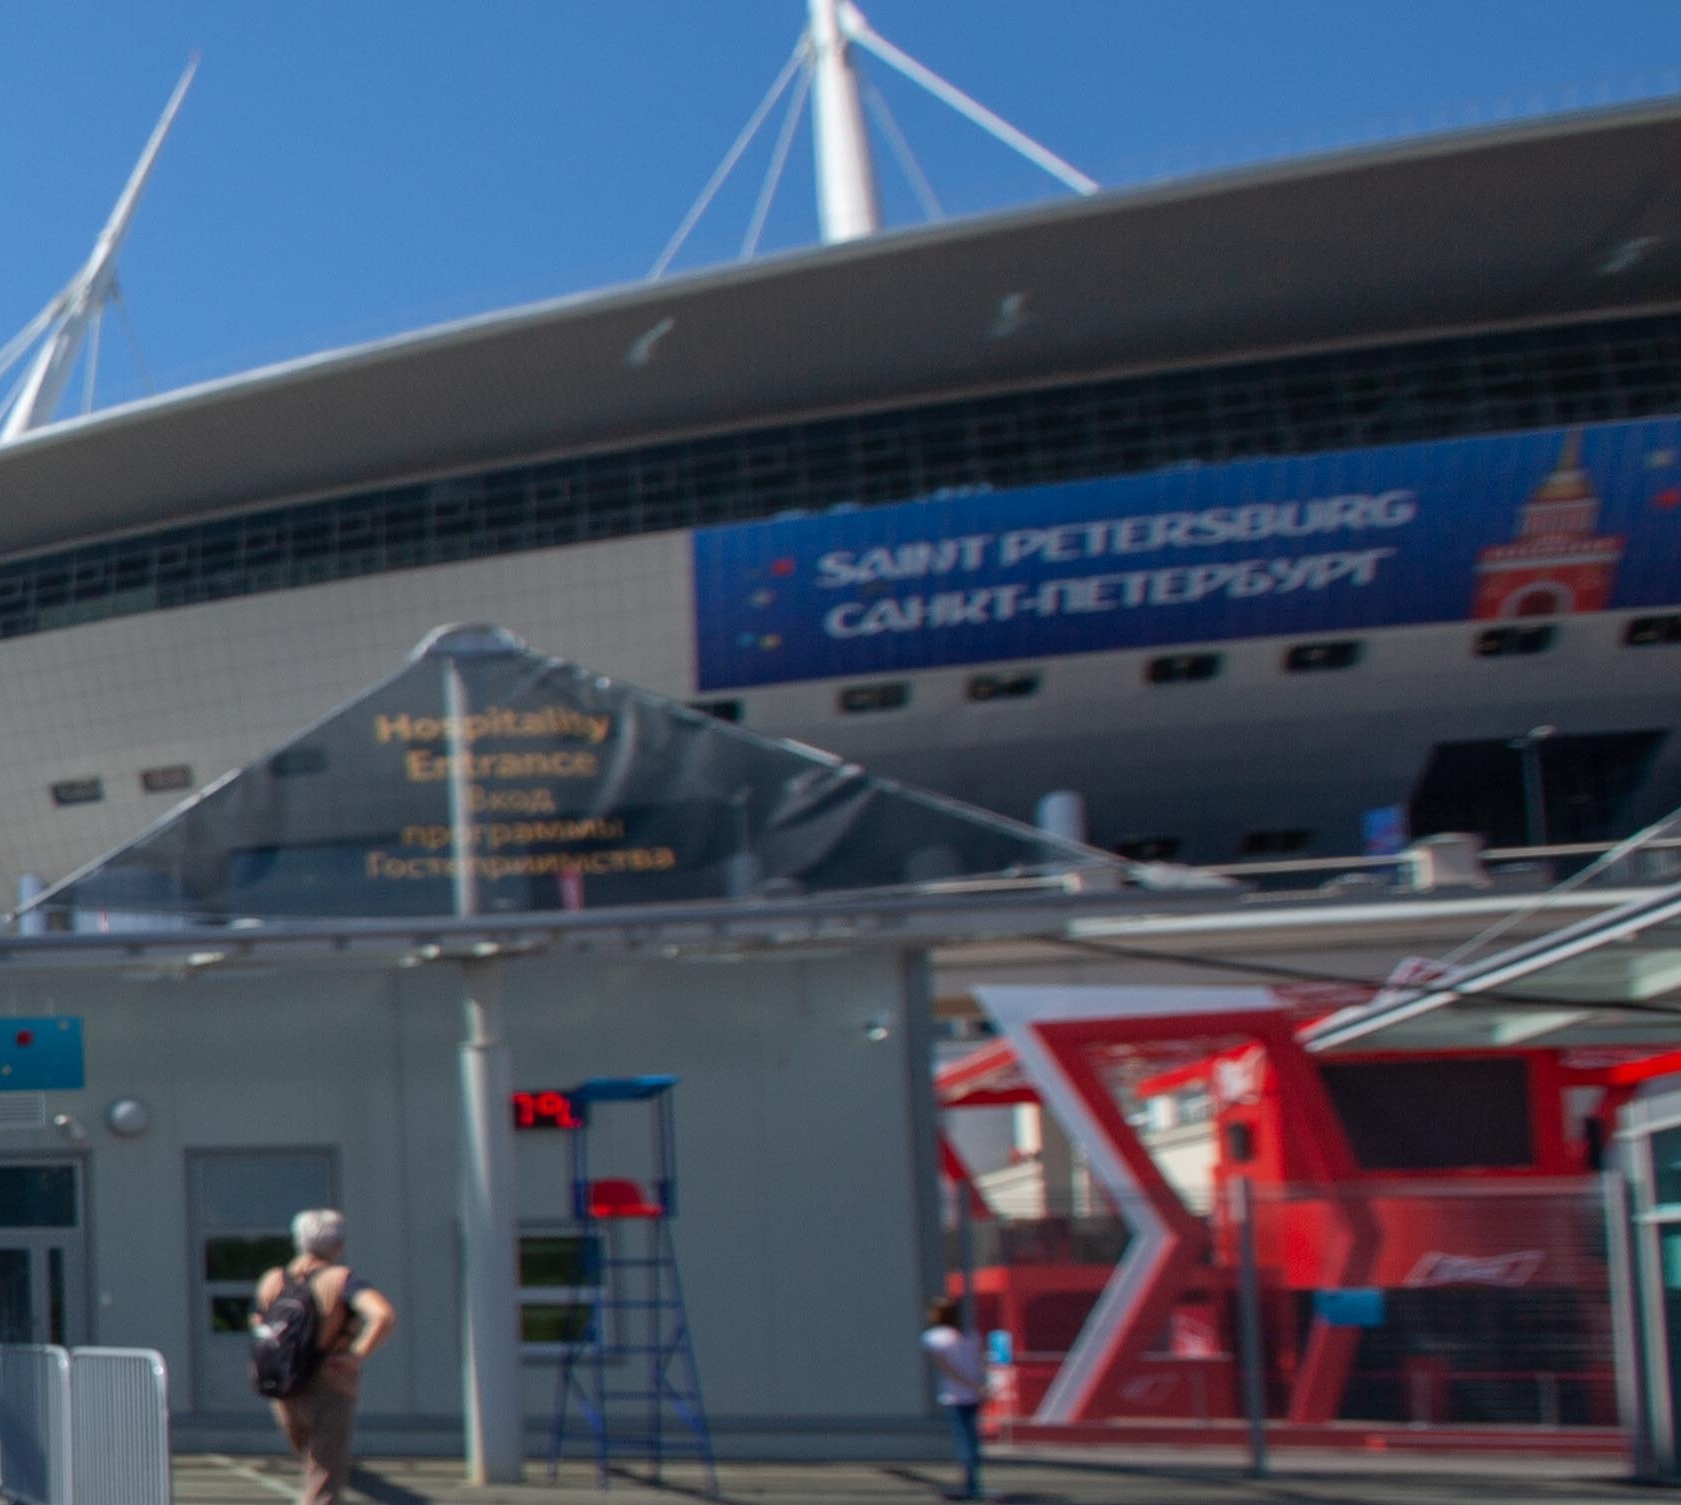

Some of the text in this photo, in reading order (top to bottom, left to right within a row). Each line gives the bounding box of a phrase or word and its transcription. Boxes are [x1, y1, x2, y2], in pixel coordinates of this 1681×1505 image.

[818, 491, 1417, 589] SAINT PETERSBURG
[824, 547, 1398, 638] САНКТ-ПЕТЕРБУРГ
[374, 705, 610, 743] Hospitality
[406, 751, 599, 782] Entrance
